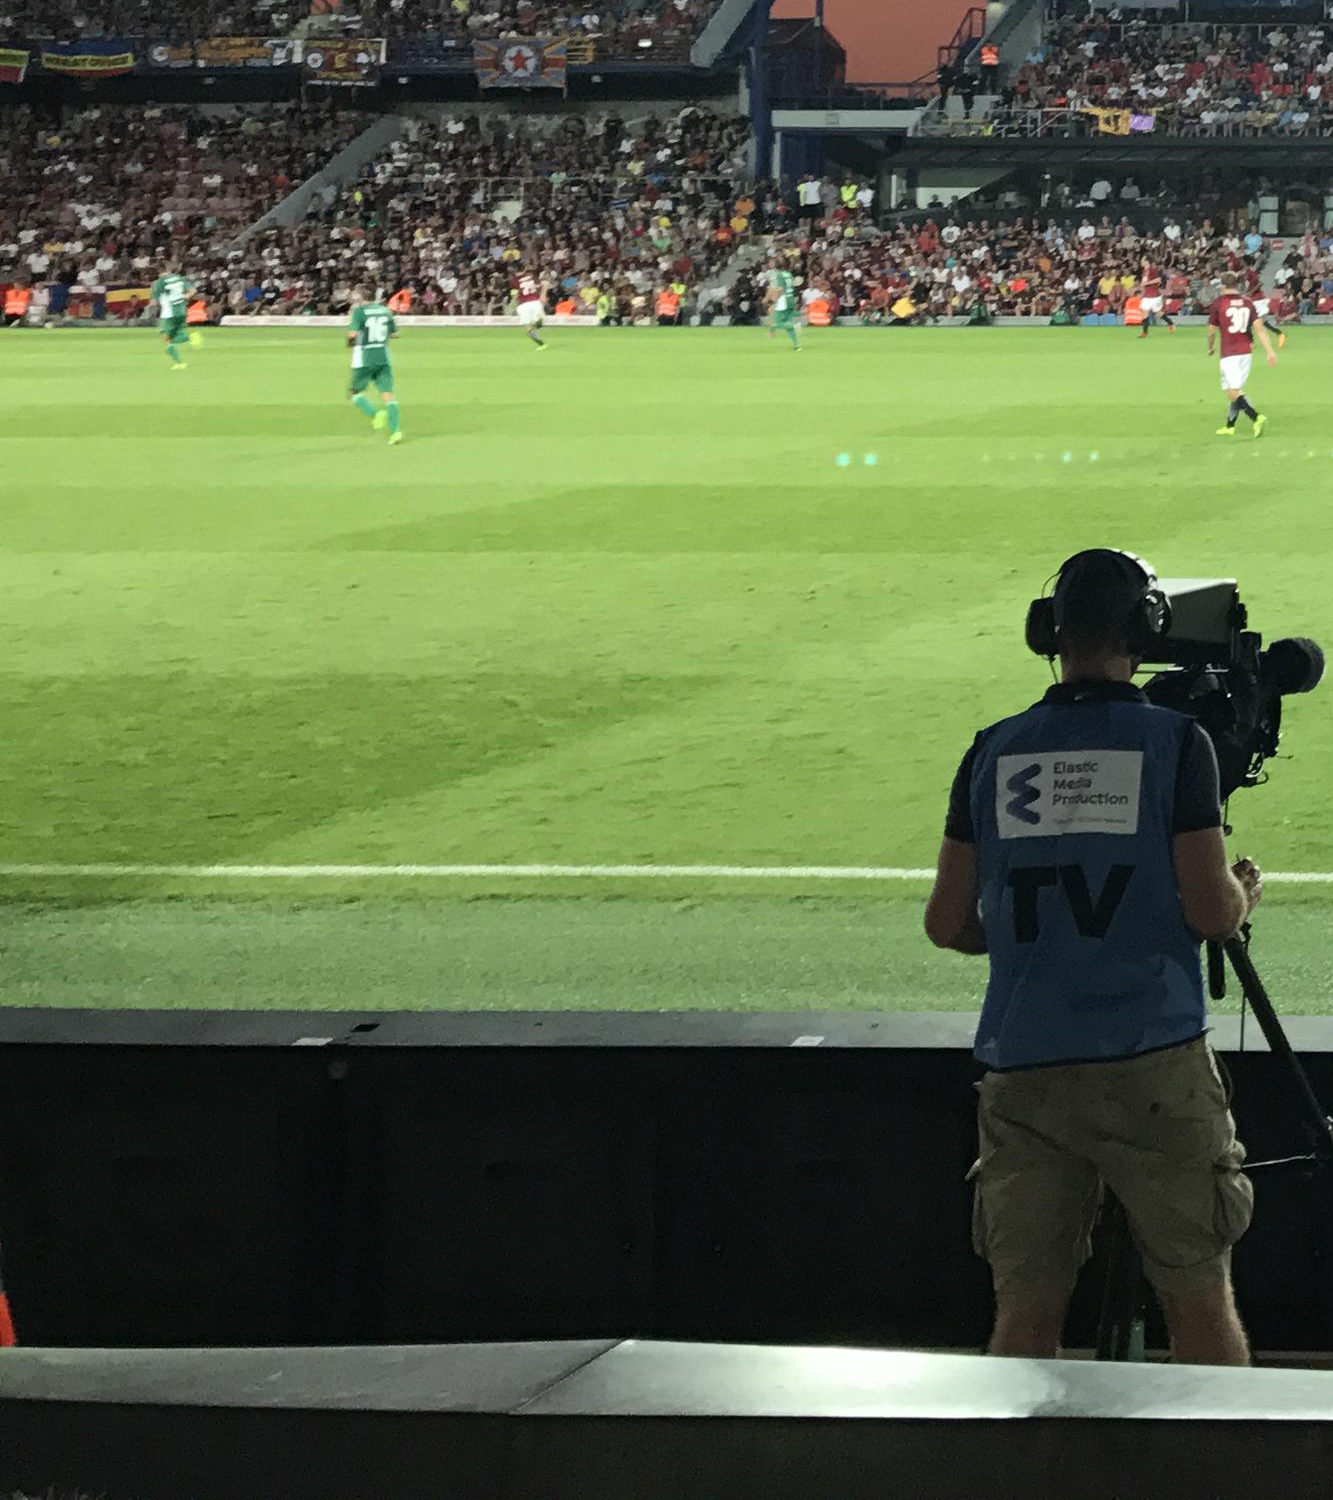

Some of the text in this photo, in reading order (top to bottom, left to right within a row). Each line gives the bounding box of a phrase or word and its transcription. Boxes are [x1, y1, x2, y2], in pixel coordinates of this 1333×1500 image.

[1225, 307, 1251, 334] 30
[1053, 761, 1099, 774] Elastic
[1053, 778, 1093, 790] Media
[1052, 792, 1129, 806] Production
[1007, 863, 1137, 944] TV
